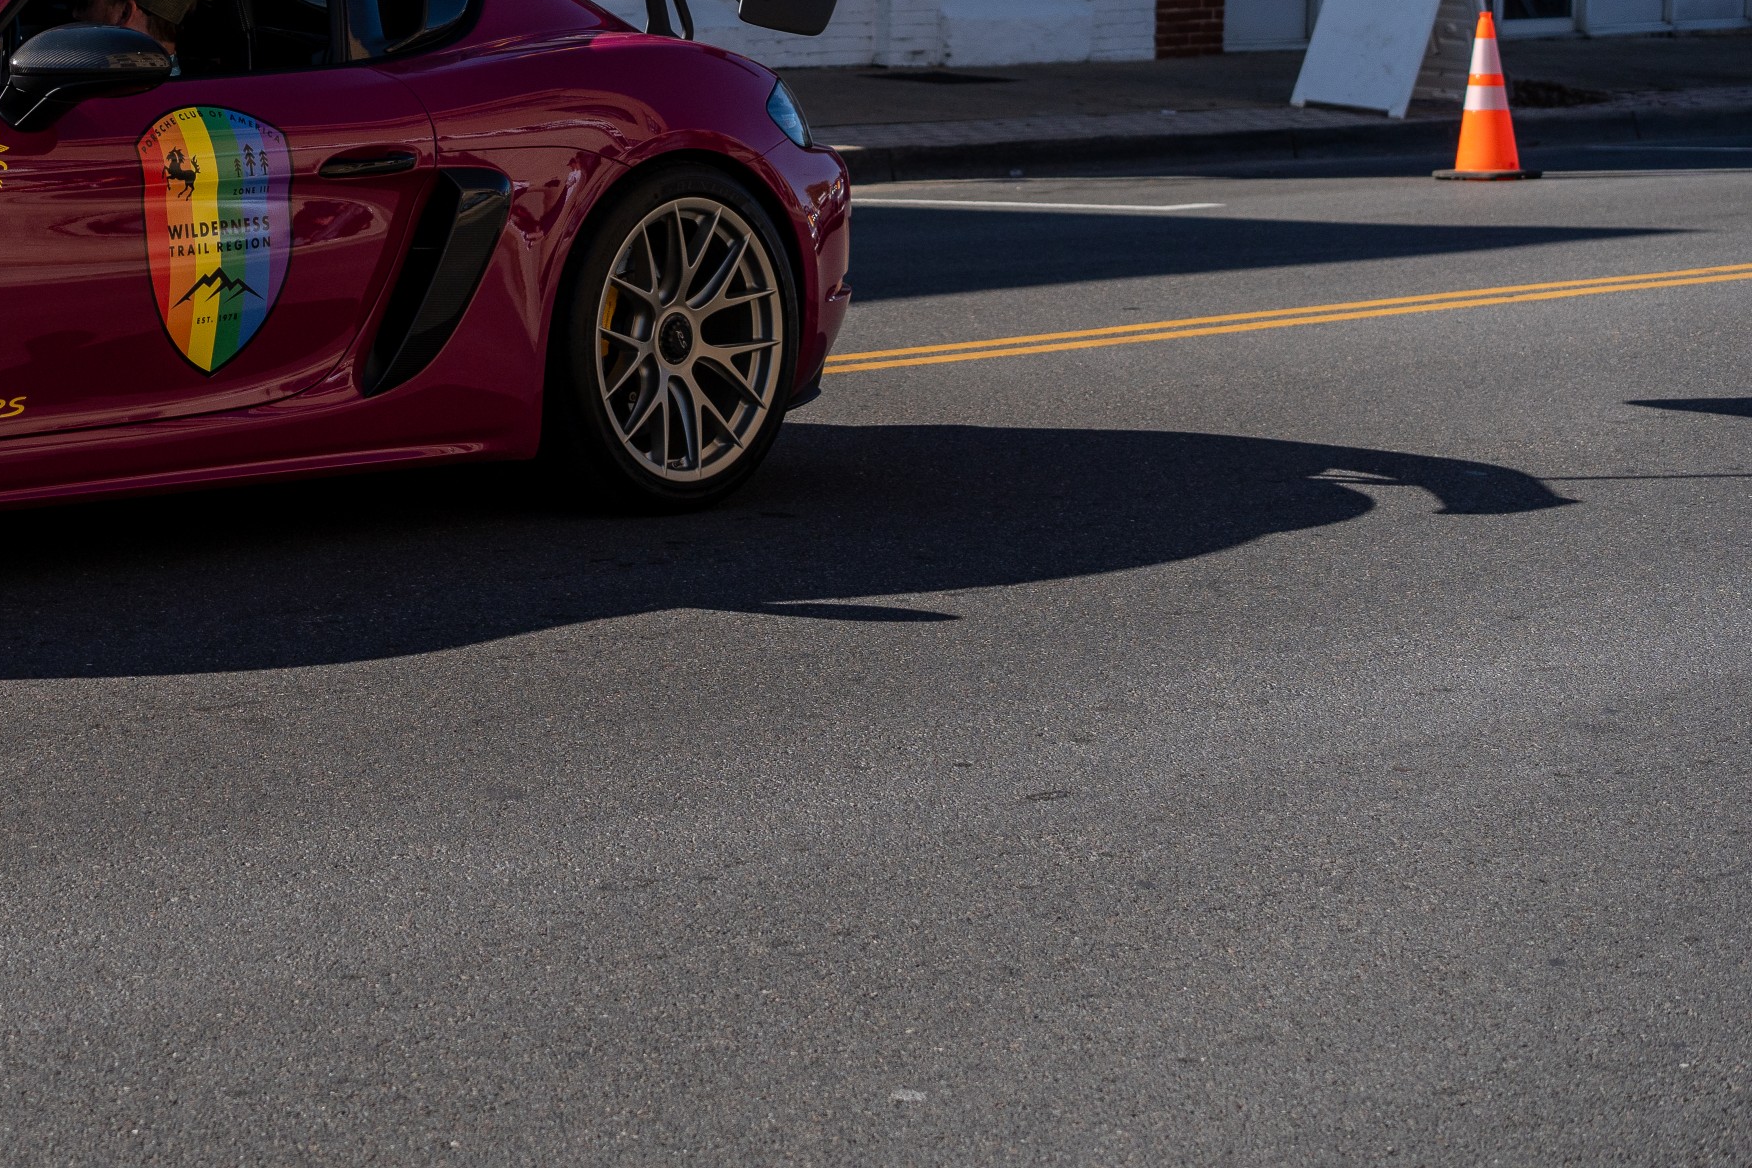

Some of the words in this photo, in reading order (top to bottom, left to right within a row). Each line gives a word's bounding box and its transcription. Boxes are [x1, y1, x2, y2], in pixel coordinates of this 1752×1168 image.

[141, 117, 177, 155] PORSCHE
[178, 112, 204, 122] CLUB
[210, 110, 223, 119] OF
[229, 113, 282, 144] AMERICA
[233, 186, 256, 196] ZONE
[168, 216, 270, 240] WILDERNESS
[169, 243, 210, 258] TRAIL
[216, 236, 271, 253] REGION
[196, 316, 214, 325] EST.
[219, 313, 238, 322] 1978
